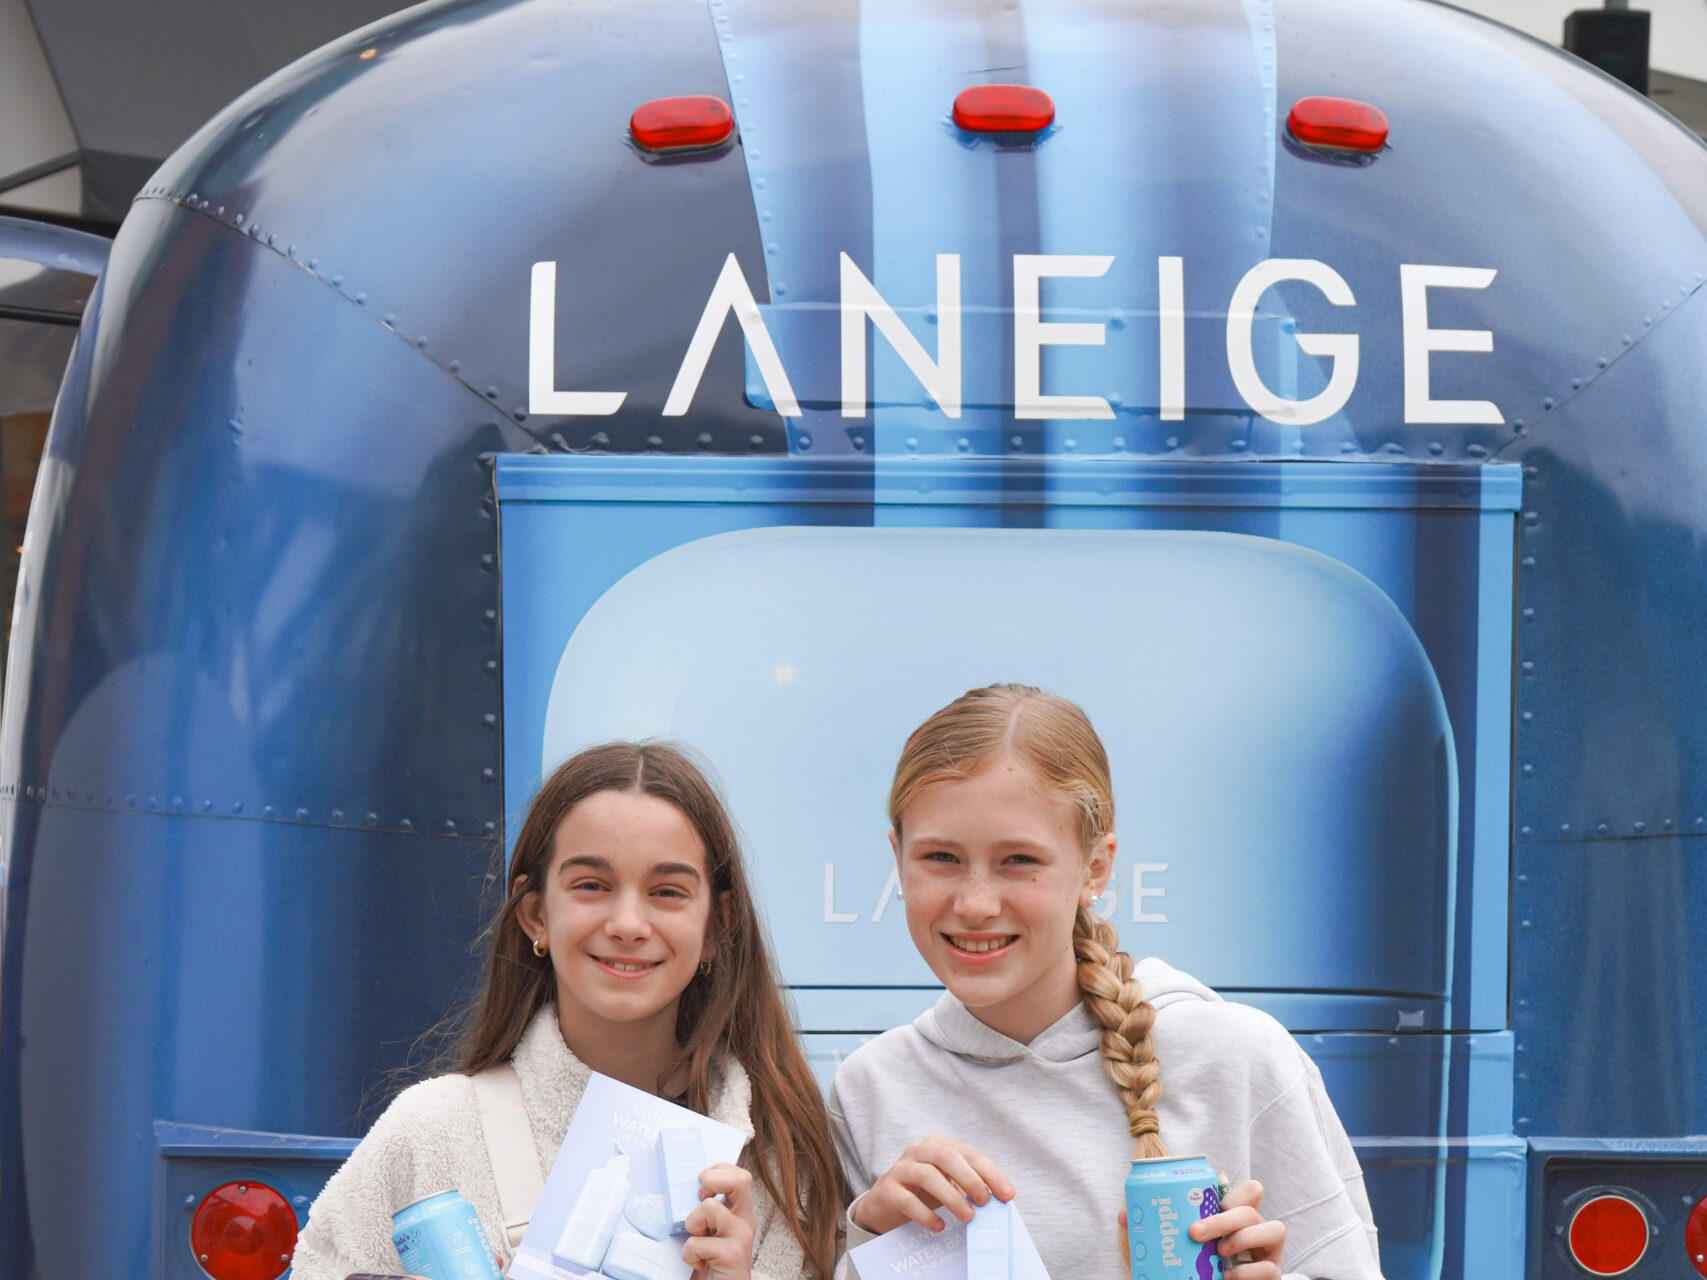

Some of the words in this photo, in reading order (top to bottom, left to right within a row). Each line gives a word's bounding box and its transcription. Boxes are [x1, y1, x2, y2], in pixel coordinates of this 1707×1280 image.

[528, 251, 1506, 426] LANEIGE
[890, 1241, 944, 1274] WATER
[1152, 1195, 1183, 1268] poppi
